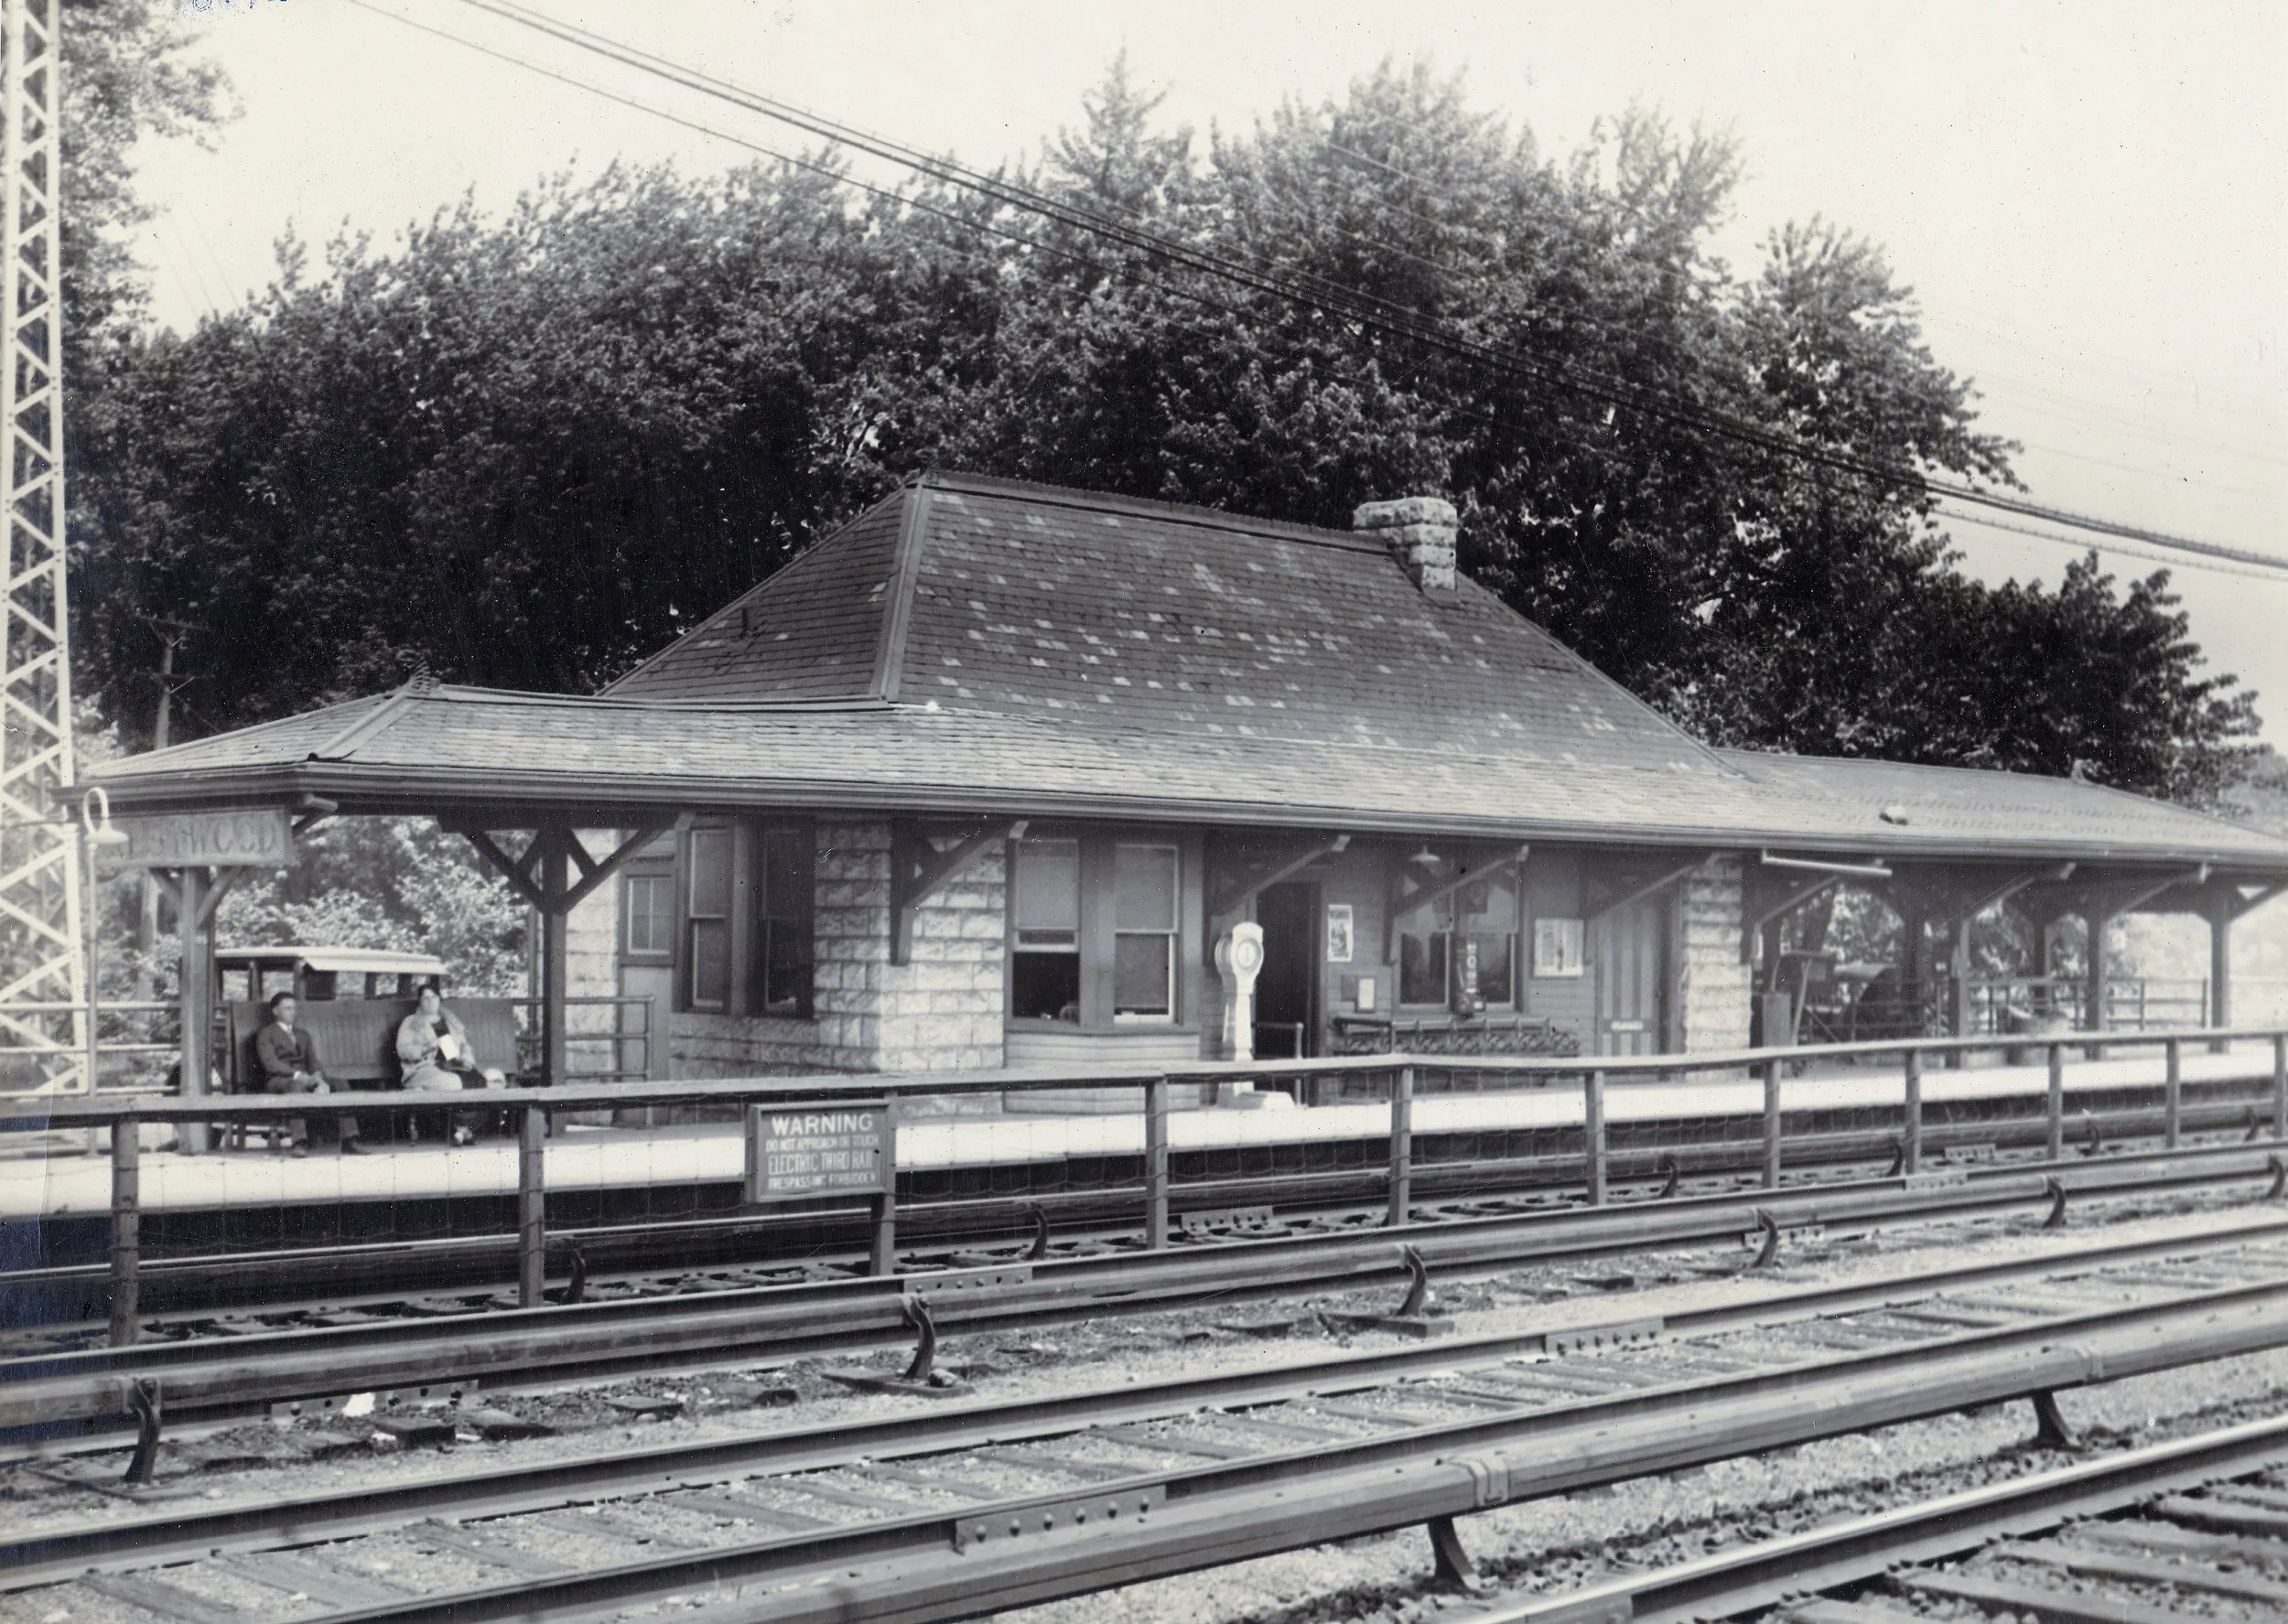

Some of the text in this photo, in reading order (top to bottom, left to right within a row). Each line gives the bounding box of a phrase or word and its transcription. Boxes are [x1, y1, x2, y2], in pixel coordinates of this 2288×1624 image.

[772, 1113, 874, 1135] WARNING
[765, 1138, 778, 1153] DO
[780, 1137, 795, 1151] NOT
[797, 1135, 837, 1150] APPROACH
[768, 1149, 873, 1176] ELECTRIC THIRD RAIL
[768, 1170, 876, 1190] TRESPASSING FORBIDDEN
